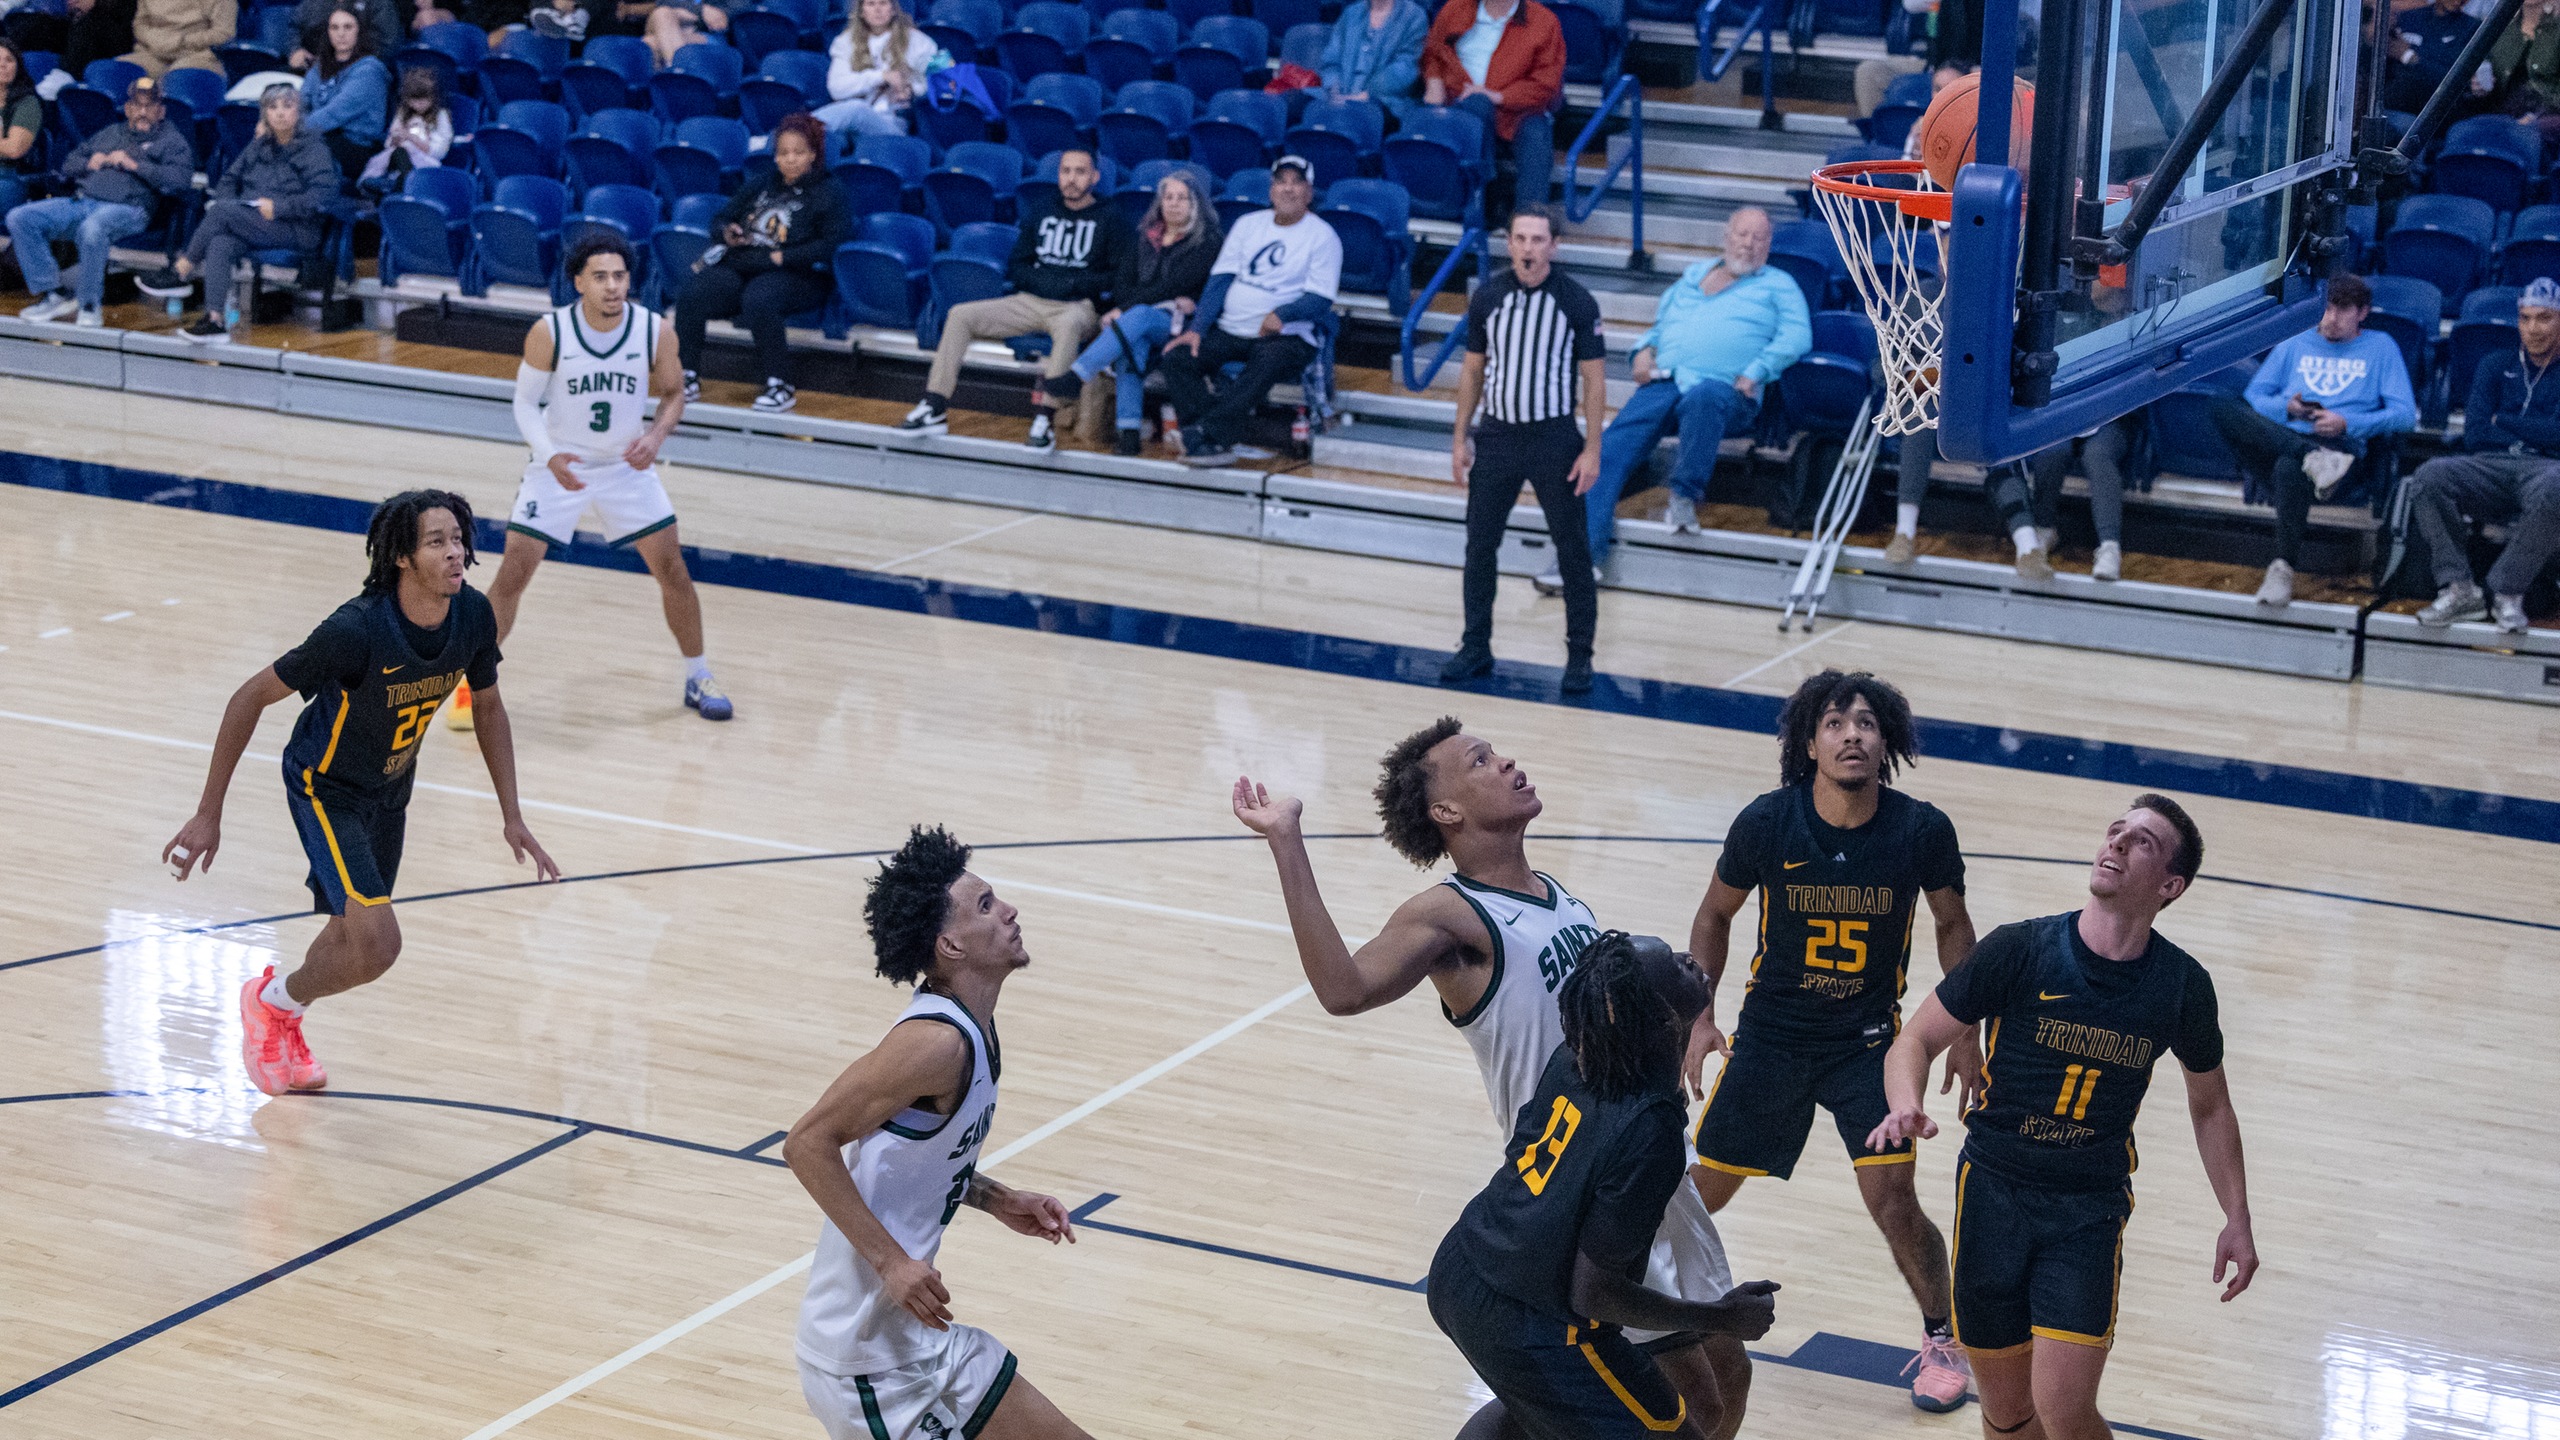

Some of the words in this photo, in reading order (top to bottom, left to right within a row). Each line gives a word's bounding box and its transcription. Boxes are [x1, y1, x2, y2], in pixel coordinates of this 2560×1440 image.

[567, 372, 637, 395] SAINTS
[589, 401, 611, 432] 3
[1786, 884, 1893, 915] TRINIDAD
[1805, 919, 1869, 973] 25
[1800, 973, 1865, 999] STATE
[2035, 1016, 2153, 1069] TRINIDAD
[2053, 1064, 2102, 1121] 11
[1516, 1095, 1582, 1196] 13
[2019, 1114, 2095, 1149] STATE
